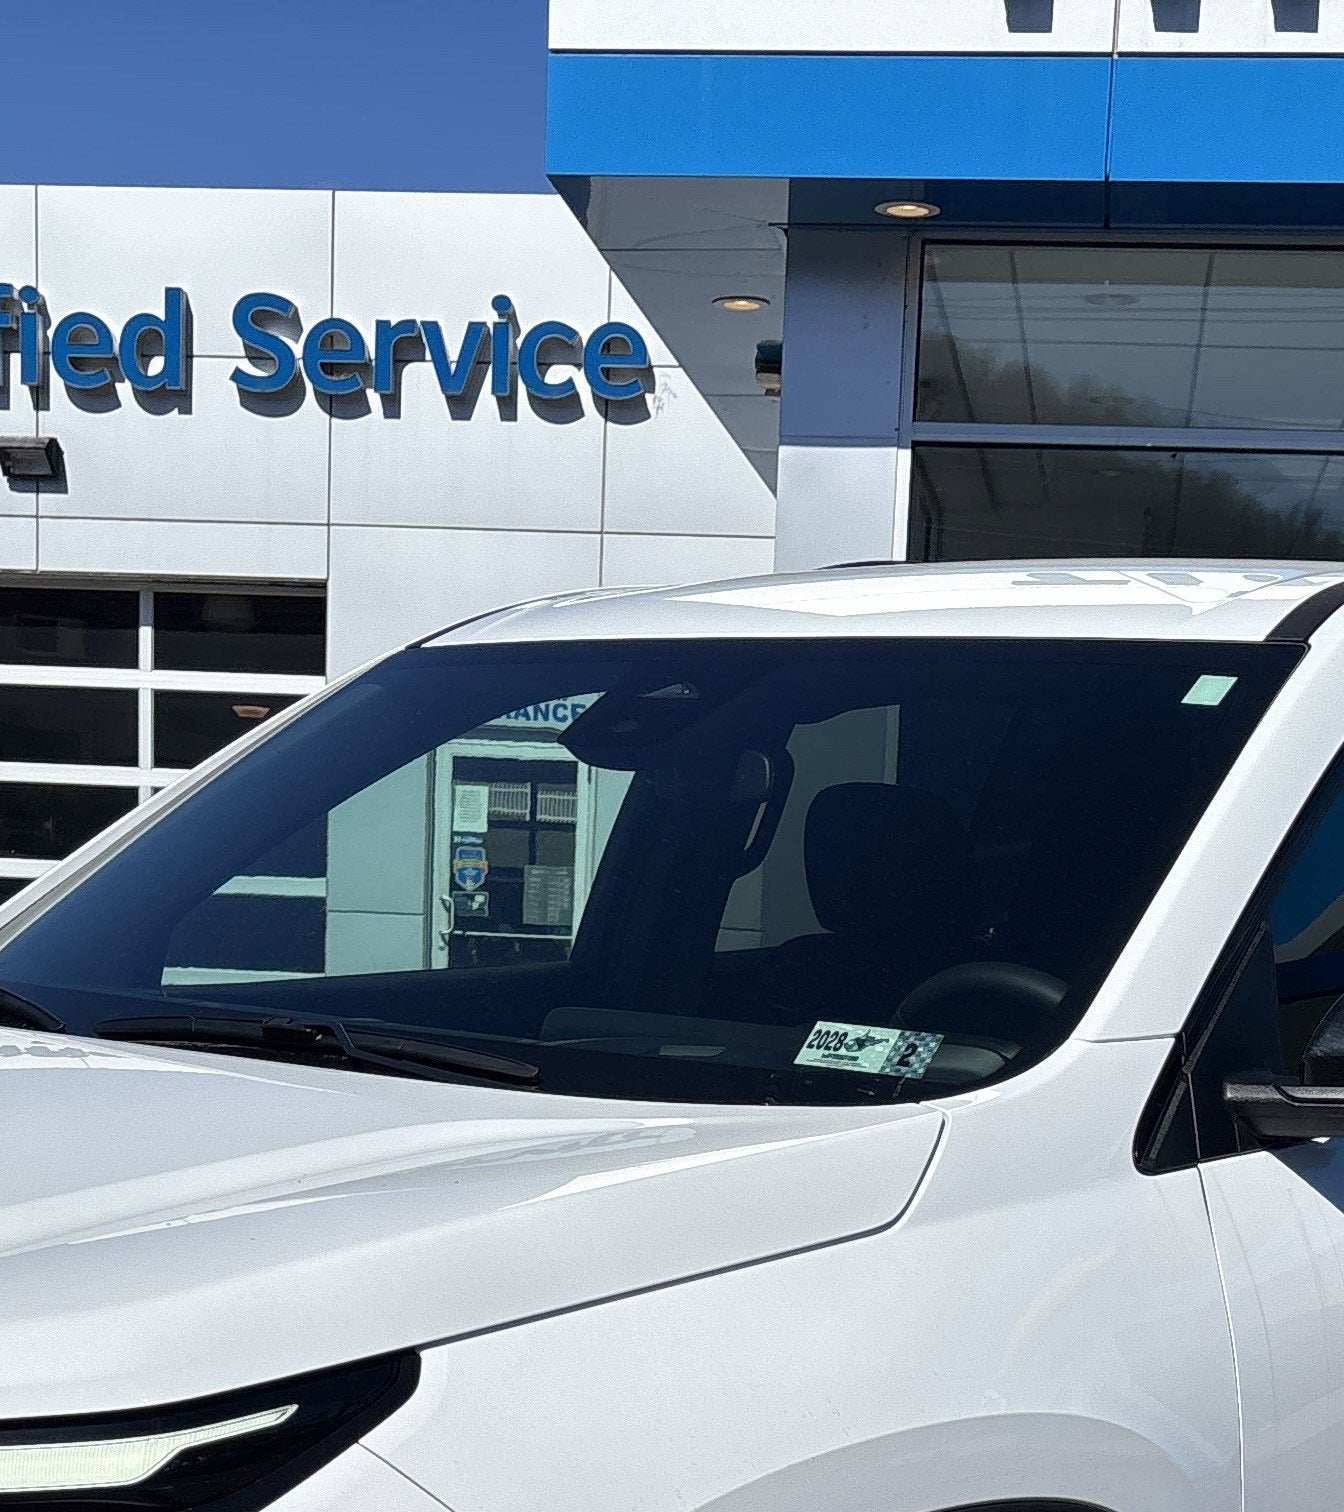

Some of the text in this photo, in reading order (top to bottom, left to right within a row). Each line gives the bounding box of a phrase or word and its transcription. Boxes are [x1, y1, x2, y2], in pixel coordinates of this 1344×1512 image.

[228, 291, 654, 401] Service
[805, 1028, 919, 1068] 2028 2
